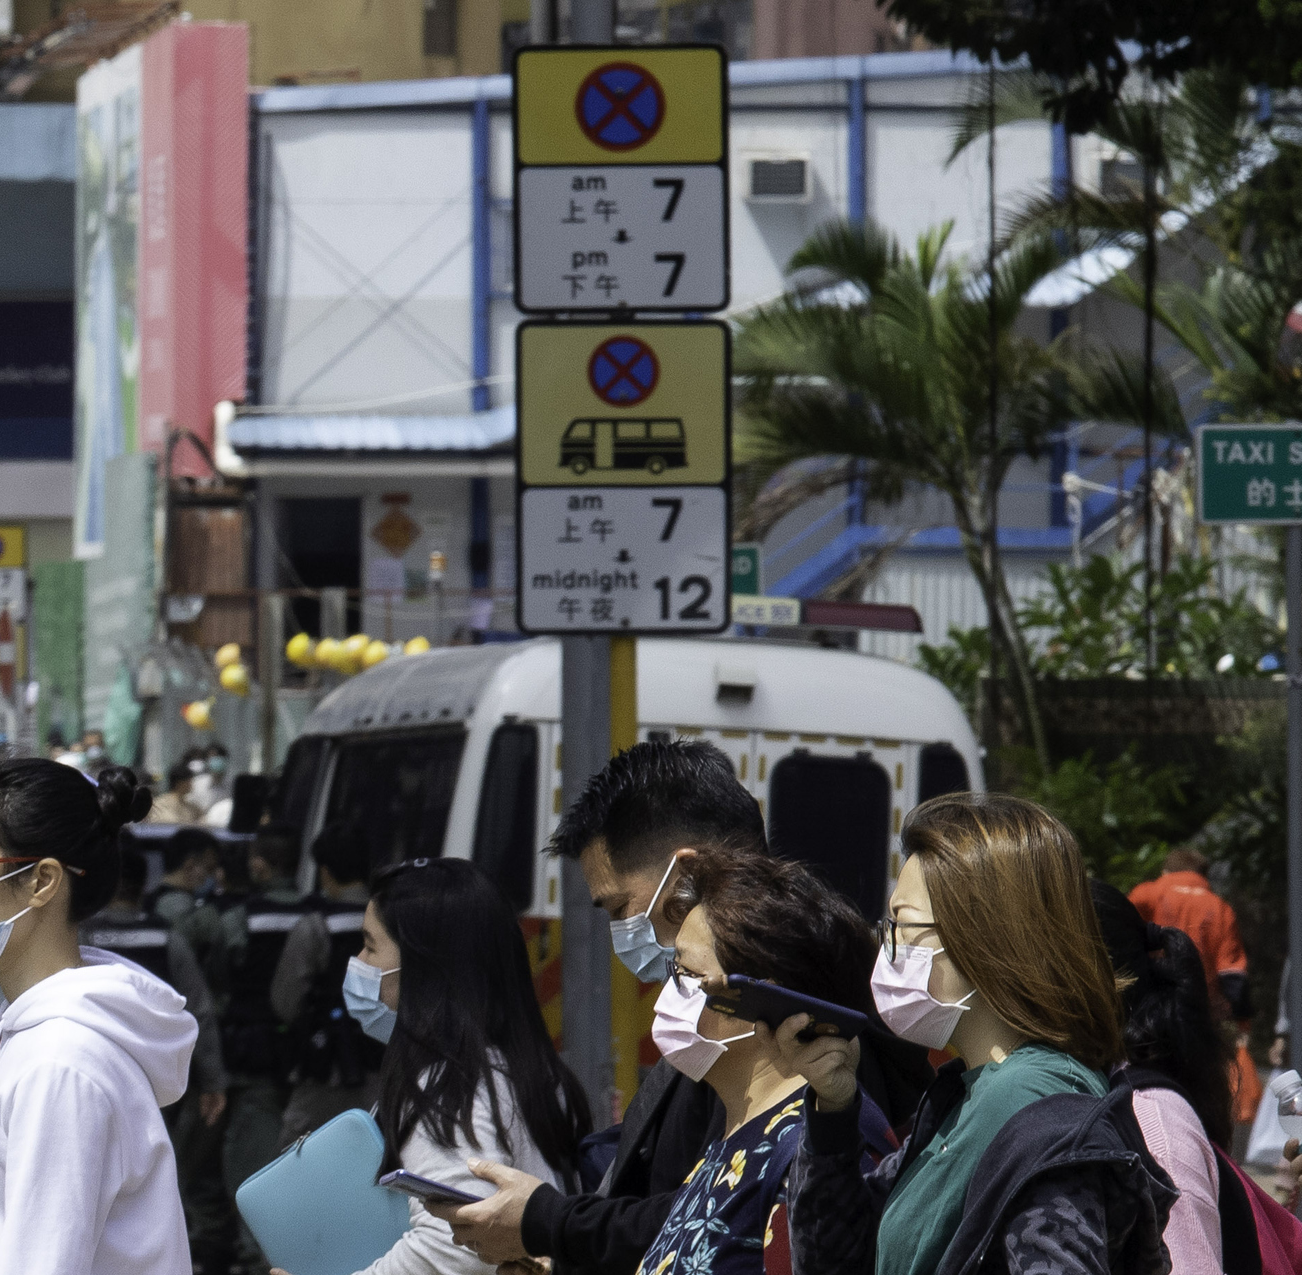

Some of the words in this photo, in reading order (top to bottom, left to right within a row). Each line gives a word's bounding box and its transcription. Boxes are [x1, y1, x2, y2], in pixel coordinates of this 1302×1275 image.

[561, 199, 619, 224] 上午
[572, 175, 607, 191] am
[653, 177, 685, 222] 7
[572, 250, 608, 268] pm
[654, 252, 686, 297] 7
[562, 275, 620, 299] 下午
[1212, 440, 1274, 464] TAXI
[557, 517, 615, 543] 上午
[567, 495, 603, 511] am
[652, 497, 683, 542] 7
[532, 569, 638, 593] midnight
[653, 574, 712, 620] 12
[558, 596, 616, 621] 午夜
